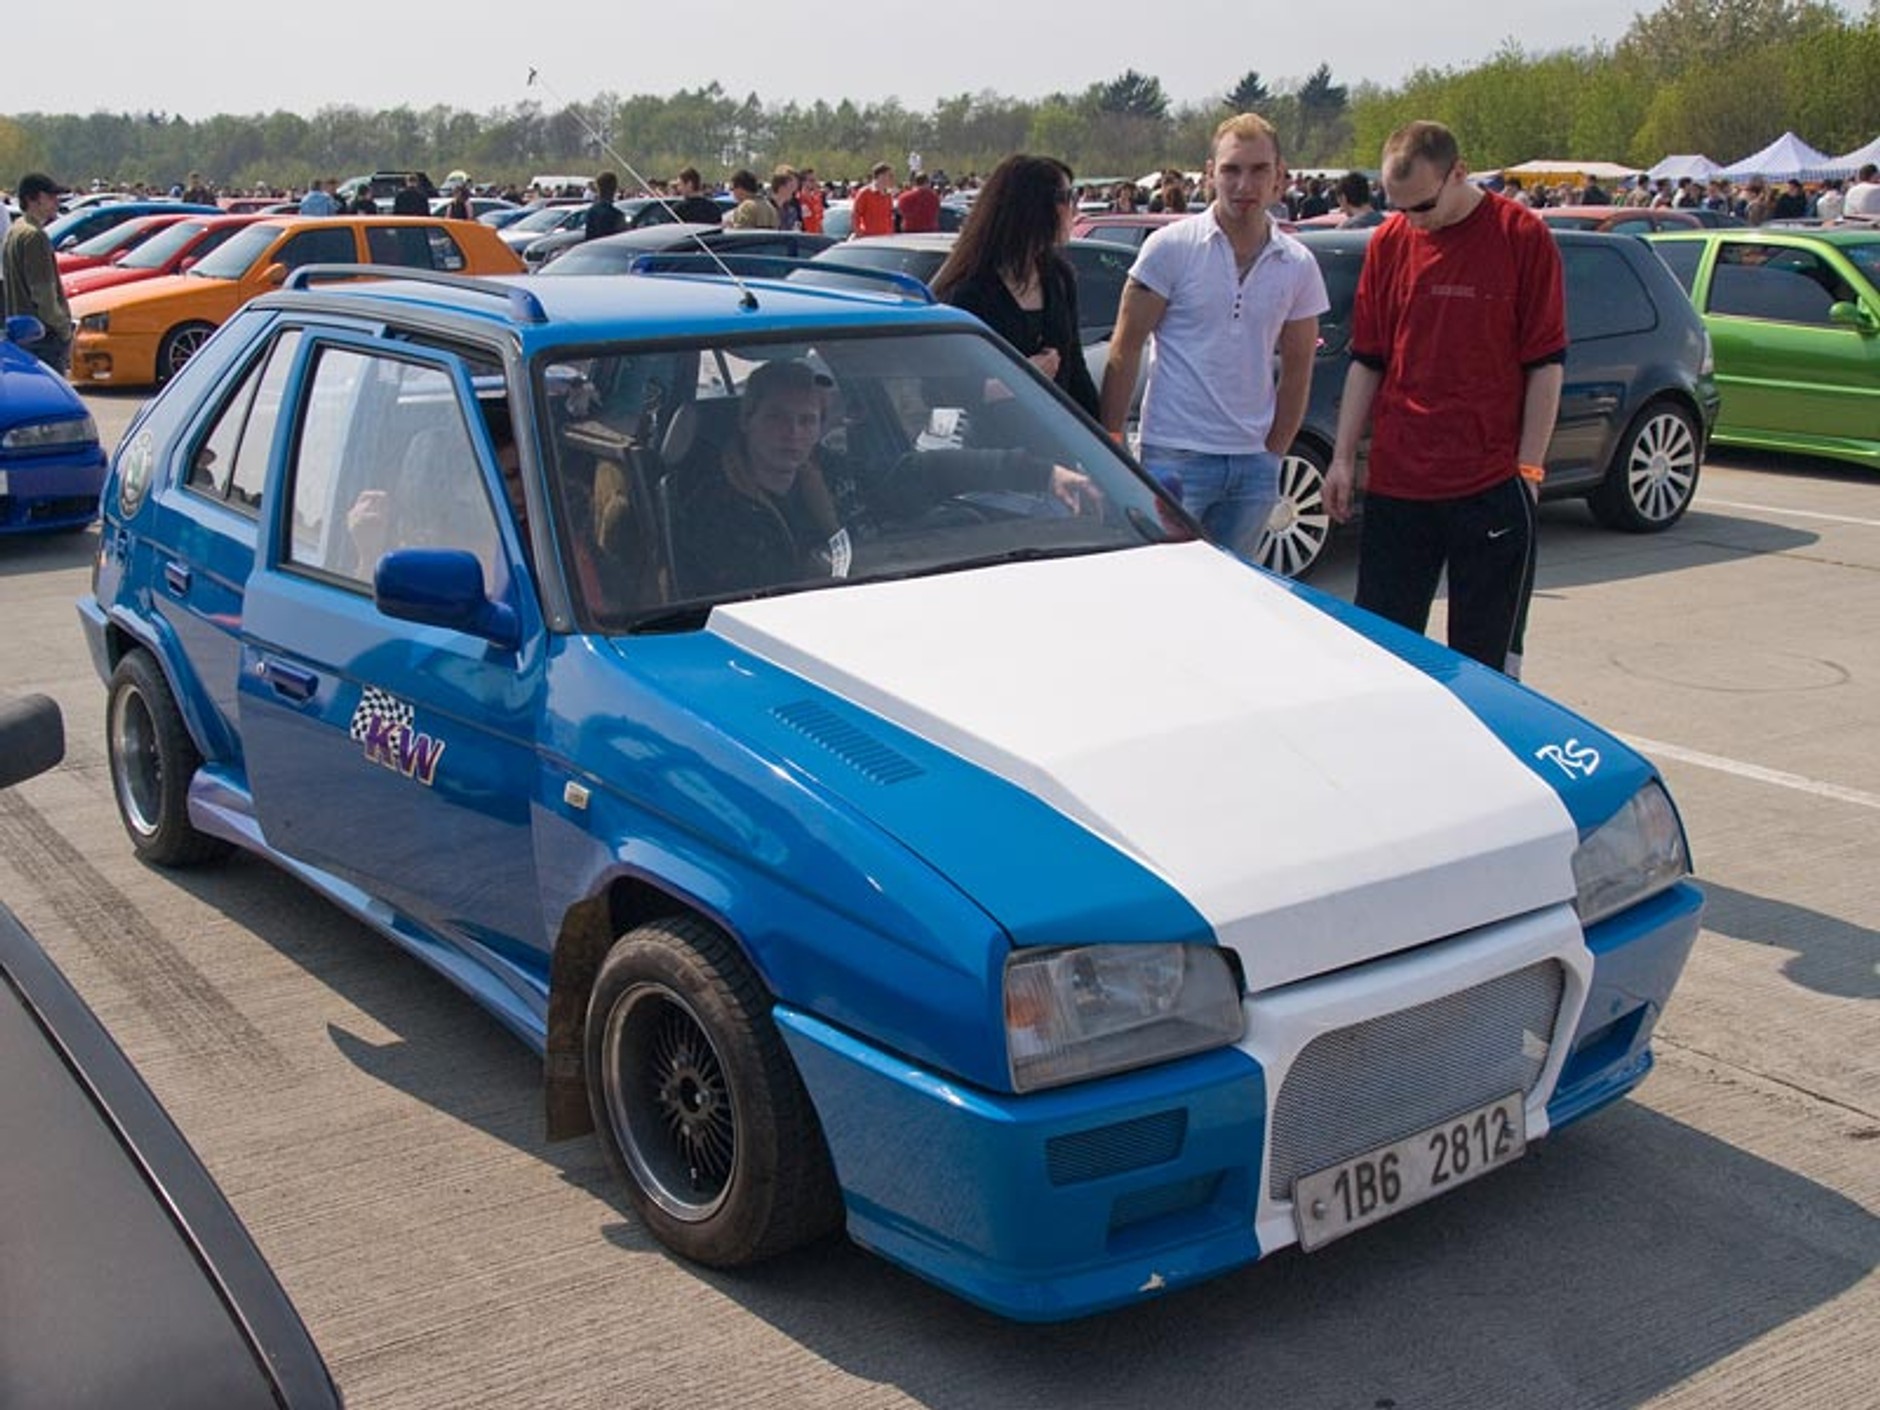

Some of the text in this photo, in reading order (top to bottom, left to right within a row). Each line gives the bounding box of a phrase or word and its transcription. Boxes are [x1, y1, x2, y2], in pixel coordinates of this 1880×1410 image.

[364, 712, 445, 787] KW
[1534, 738, 1600, 780] RS
[1334, 1106, 1511, 1222] 1B6 2812
